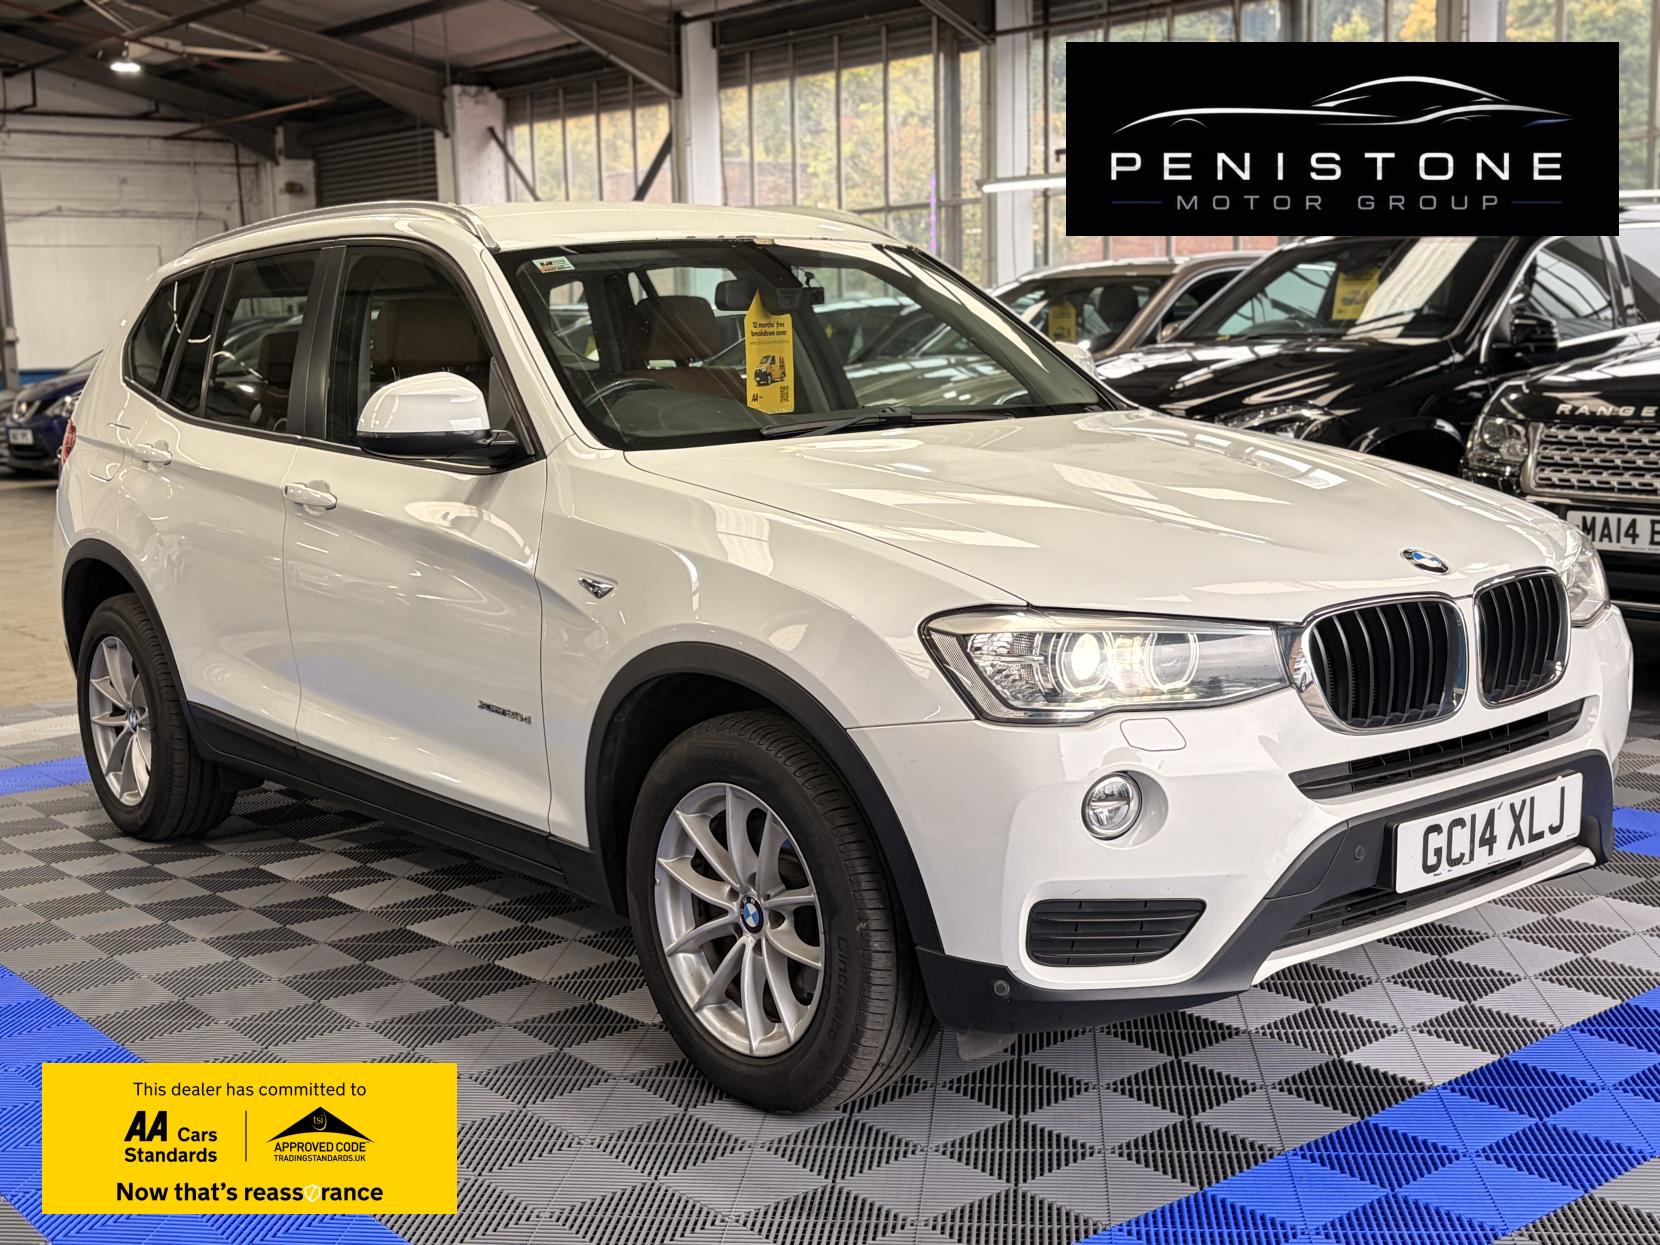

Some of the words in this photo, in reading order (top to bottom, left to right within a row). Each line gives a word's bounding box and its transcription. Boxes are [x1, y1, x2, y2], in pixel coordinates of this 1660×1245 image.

[1556, 403, 1659, 417] RANGE
[1581, 515, 1639, 545] MA14
[1421, 807, 1498, 875] GC14
[1507, 786, 1566, 850] XLJ
